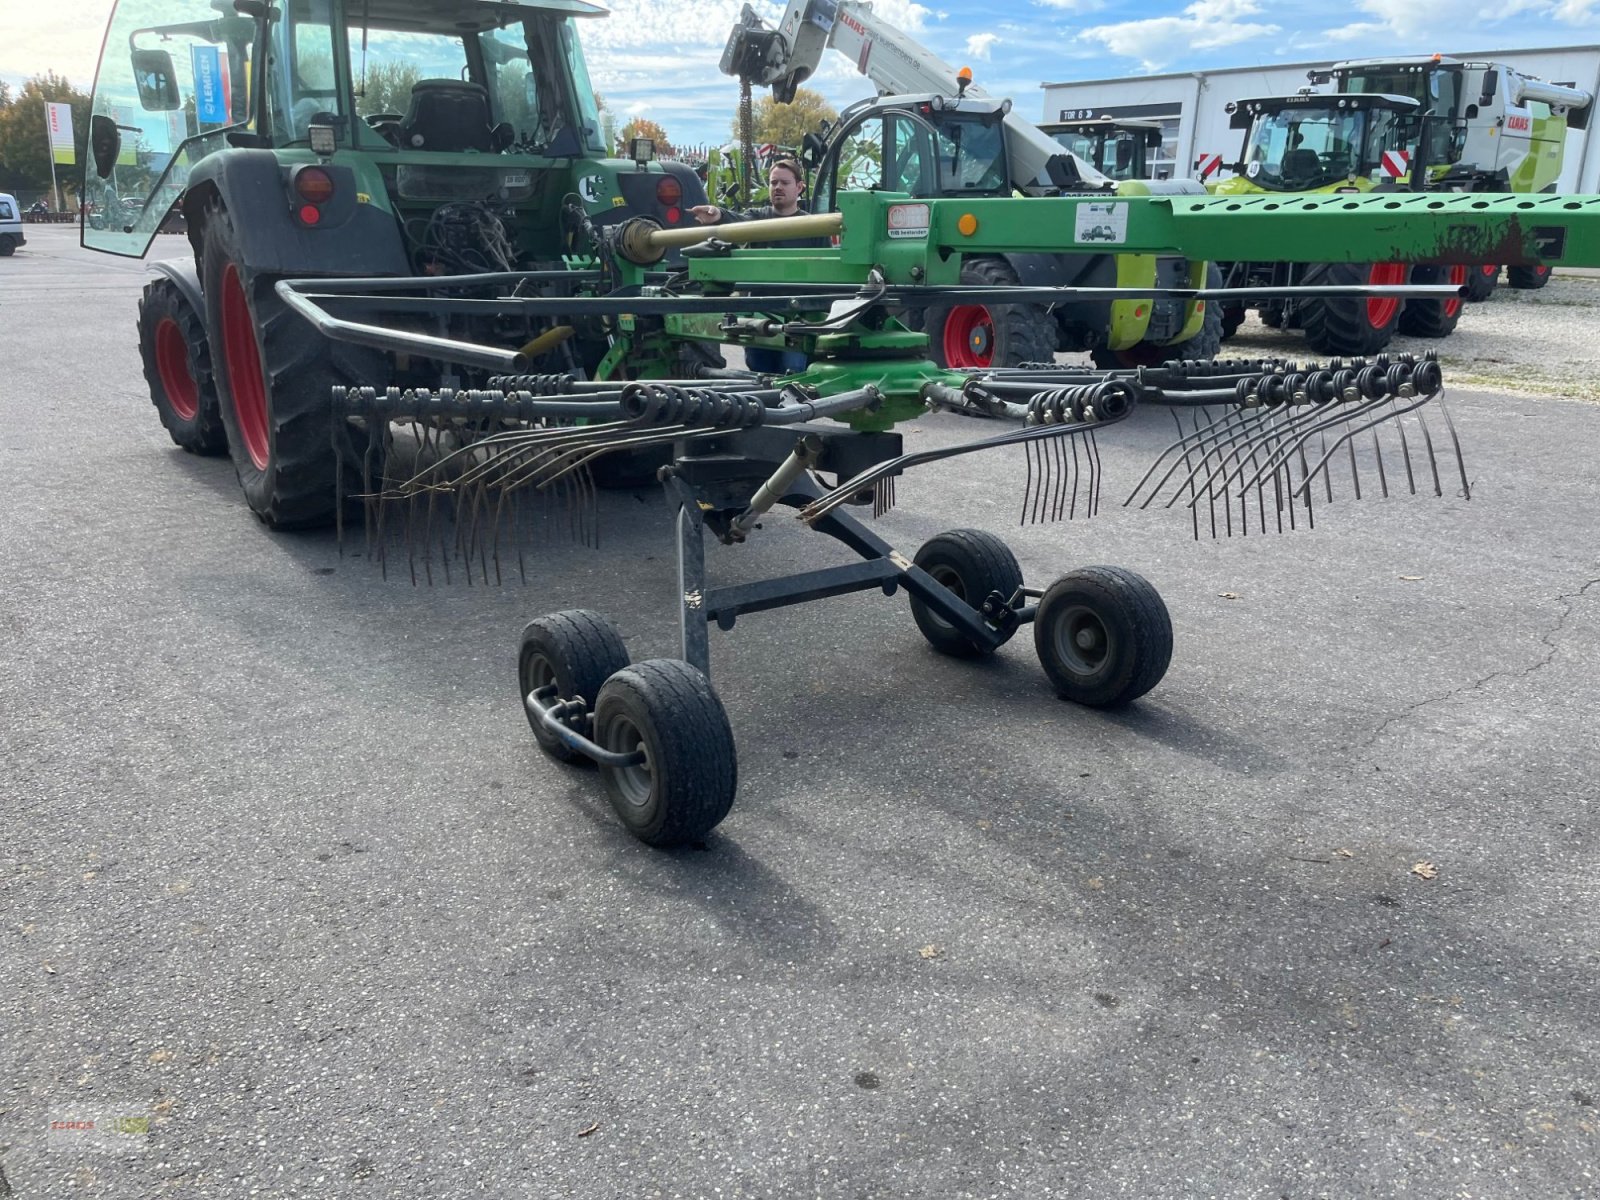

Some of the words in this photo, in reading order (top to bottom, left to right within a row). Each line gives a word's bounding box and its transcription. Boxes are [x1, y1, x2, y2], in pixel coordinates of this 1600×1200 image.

[840, 12, 865, 36] CLAAS
[200, 54, 214, 99] LEMKEN
[1064, 111, 1075, 119] TOR
[1078, 111, 1083, 119] 6
[1507, 116, 1529, 131] CLAAS
